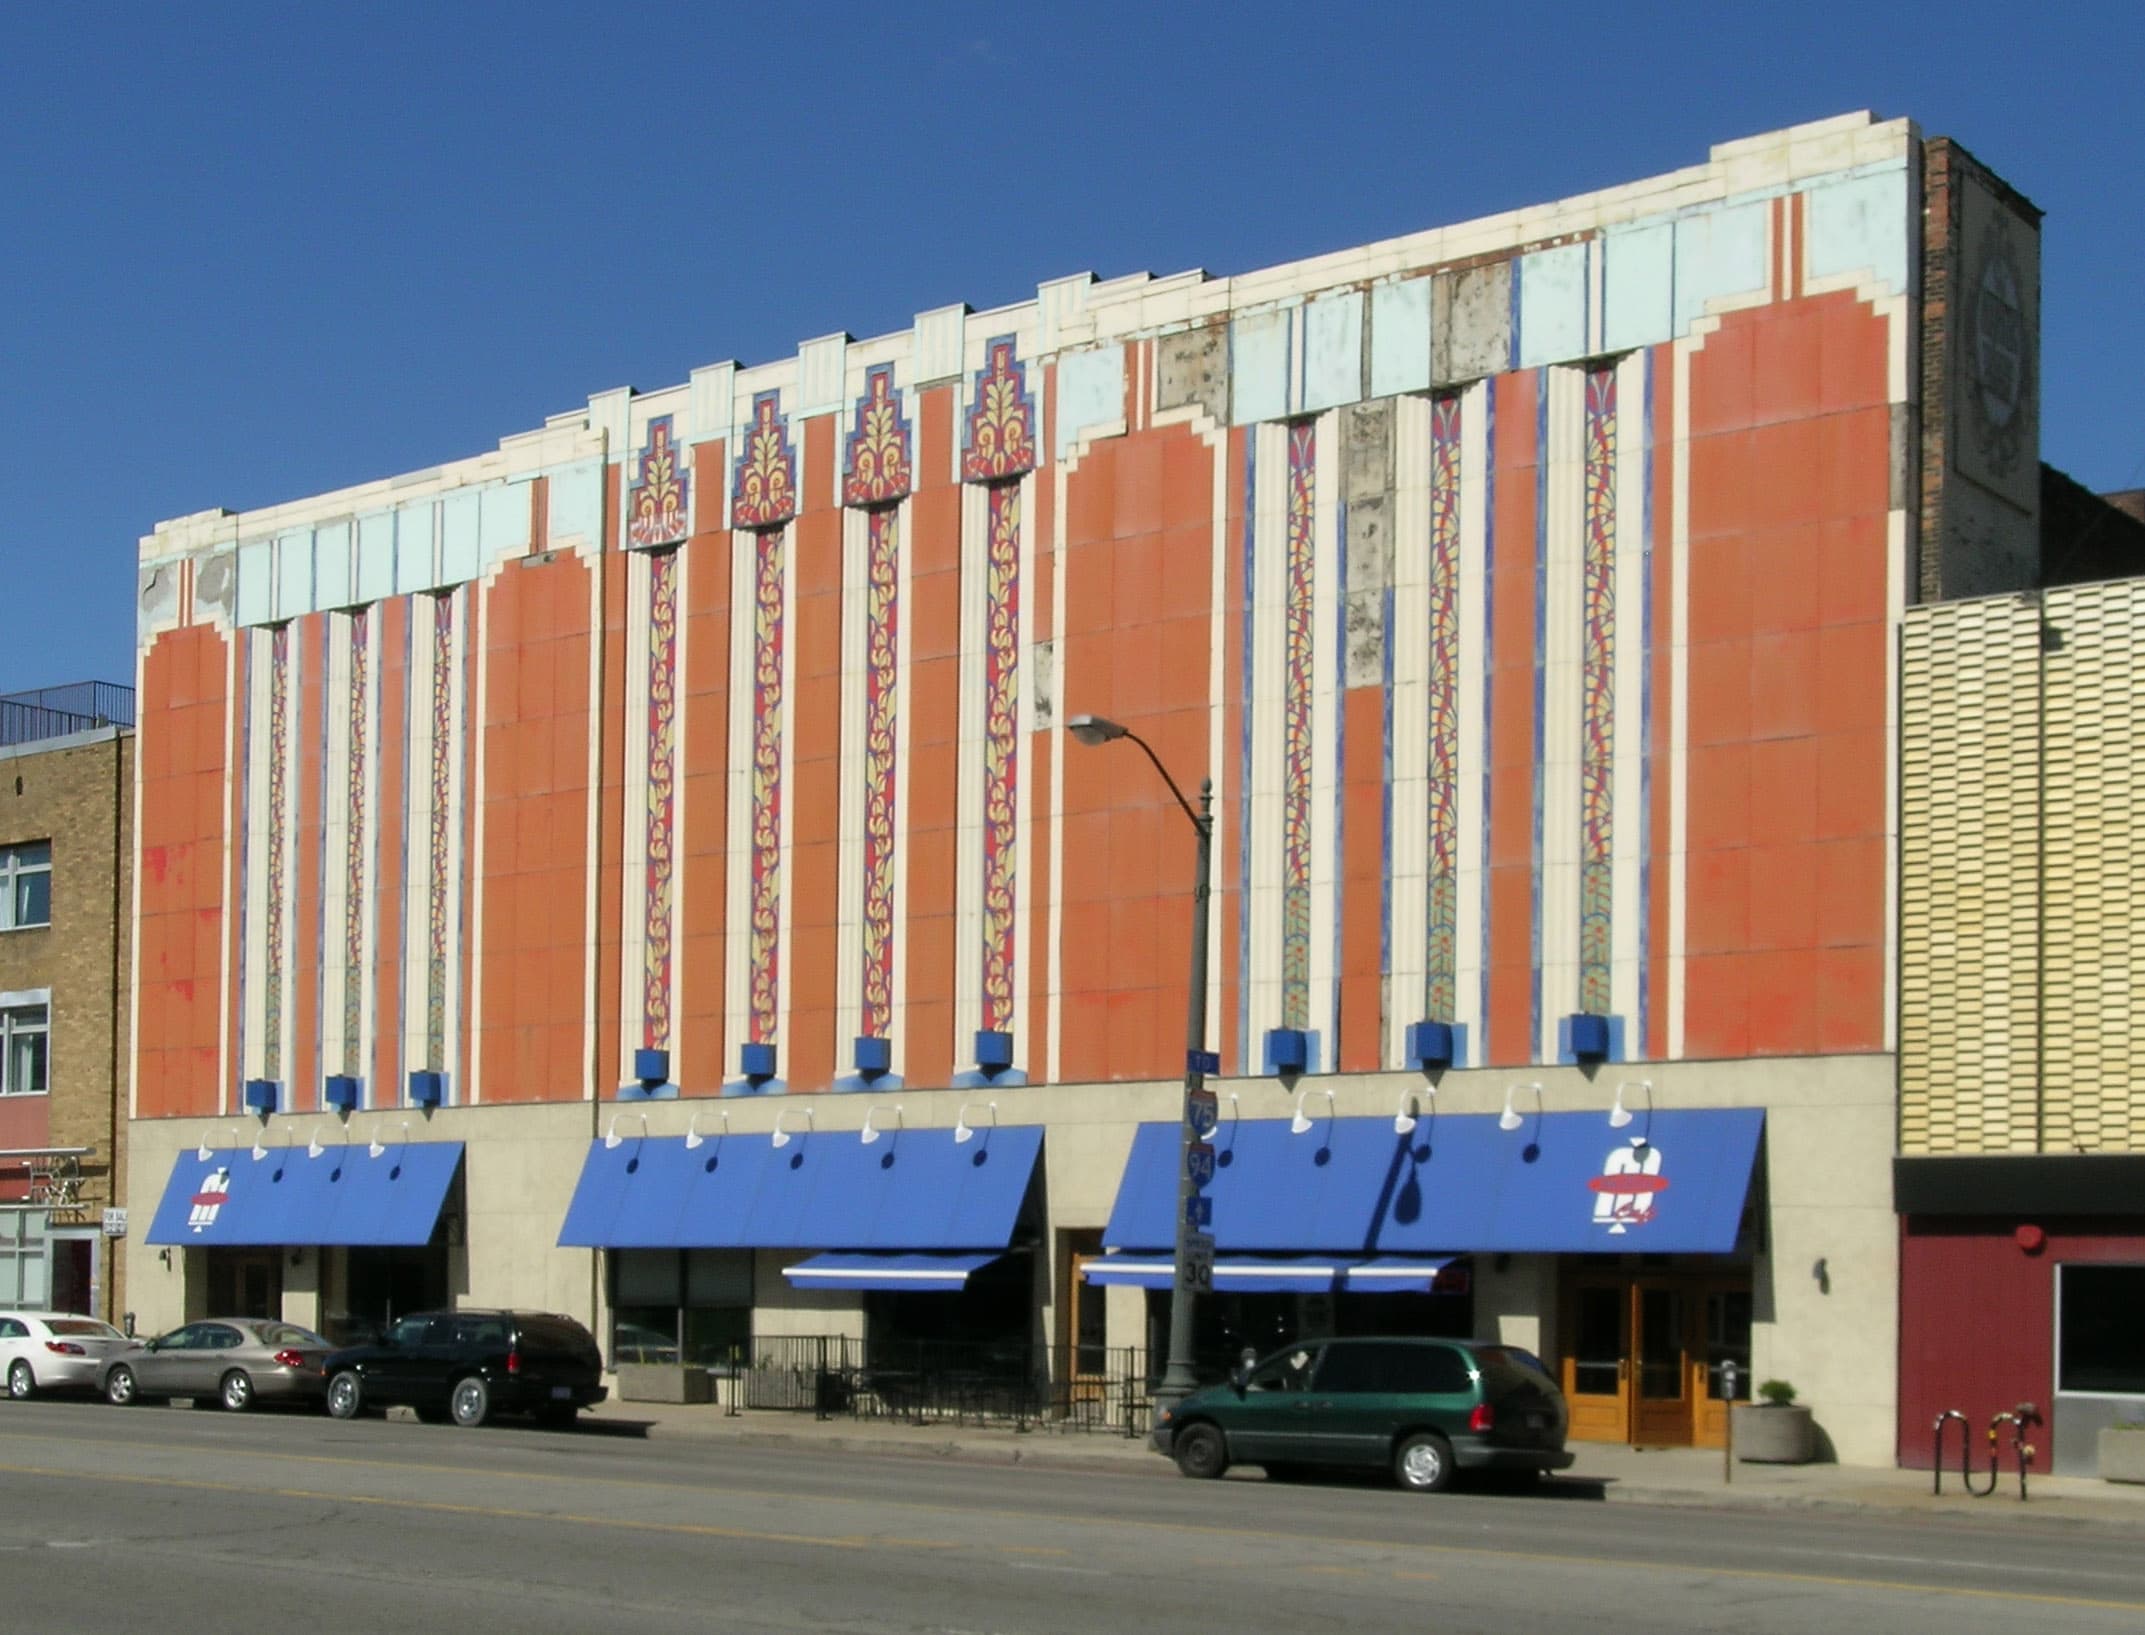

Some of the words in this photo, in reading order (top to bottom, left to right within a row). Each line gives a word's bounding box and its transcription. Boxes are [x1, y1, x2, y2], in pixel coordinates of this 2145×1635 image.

[1192, 1102, 1215, 1127] 75
[1190, 1154, 1212, 1177] 94
[1186, 1262, 1210, 1285] 30
